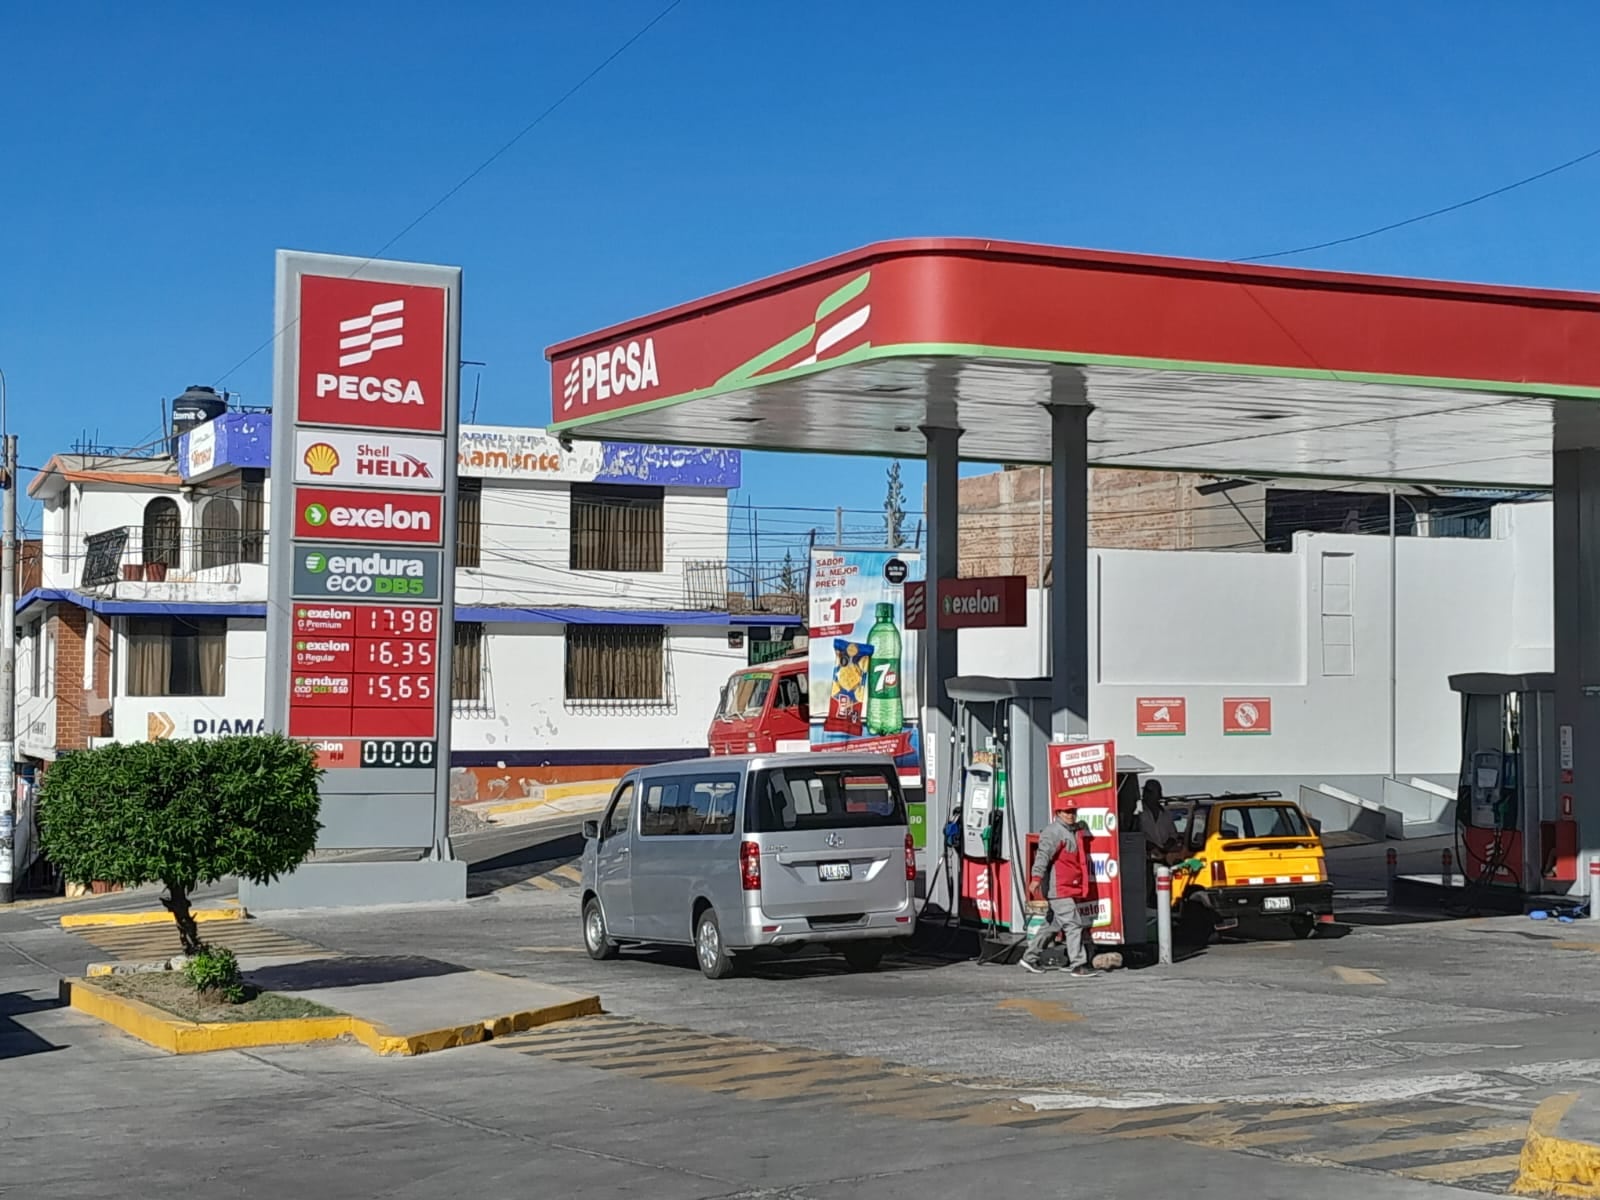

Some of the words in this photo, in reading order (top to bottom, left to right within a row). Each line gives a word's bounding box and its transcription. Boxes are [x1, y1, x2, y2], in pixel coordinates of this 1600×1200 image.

[582, 338, 659, 405] PECSA
[316, 373, 425, 405] PECSA
[357, 445, 390, 457] Shell
[356, 458, 434, 478] HELIX
[329, 503, 431, 530] exelon
[328, 553, 424, 576] endura
[816, 557, 844, 566] SABOR
[829, 567, 857, 576] MEJOR
[326, 575, 372, 592] eco
[374, 578, 424, 594] DB5
[815, 579, 846, 588] PRECIO
[953, 588, 999, 614] exelon
[306, 620, 342, 628] Premium
[307, 608, 351, 620] exelon
[371, 609, 433, 635] 17.98
[305, 653, 335, 662] Regular
[306, 640, 350, 652] exelon
[370, 642, 432, 667] 16.35
[304, 676, 348, 686] endura
[368, 675, 430, 701] 15.65
[364, 741, 433, 767] 00.00
[1070, 765, 1092, 777] TIPOS
[1093, 762, 1103, 772] DE
